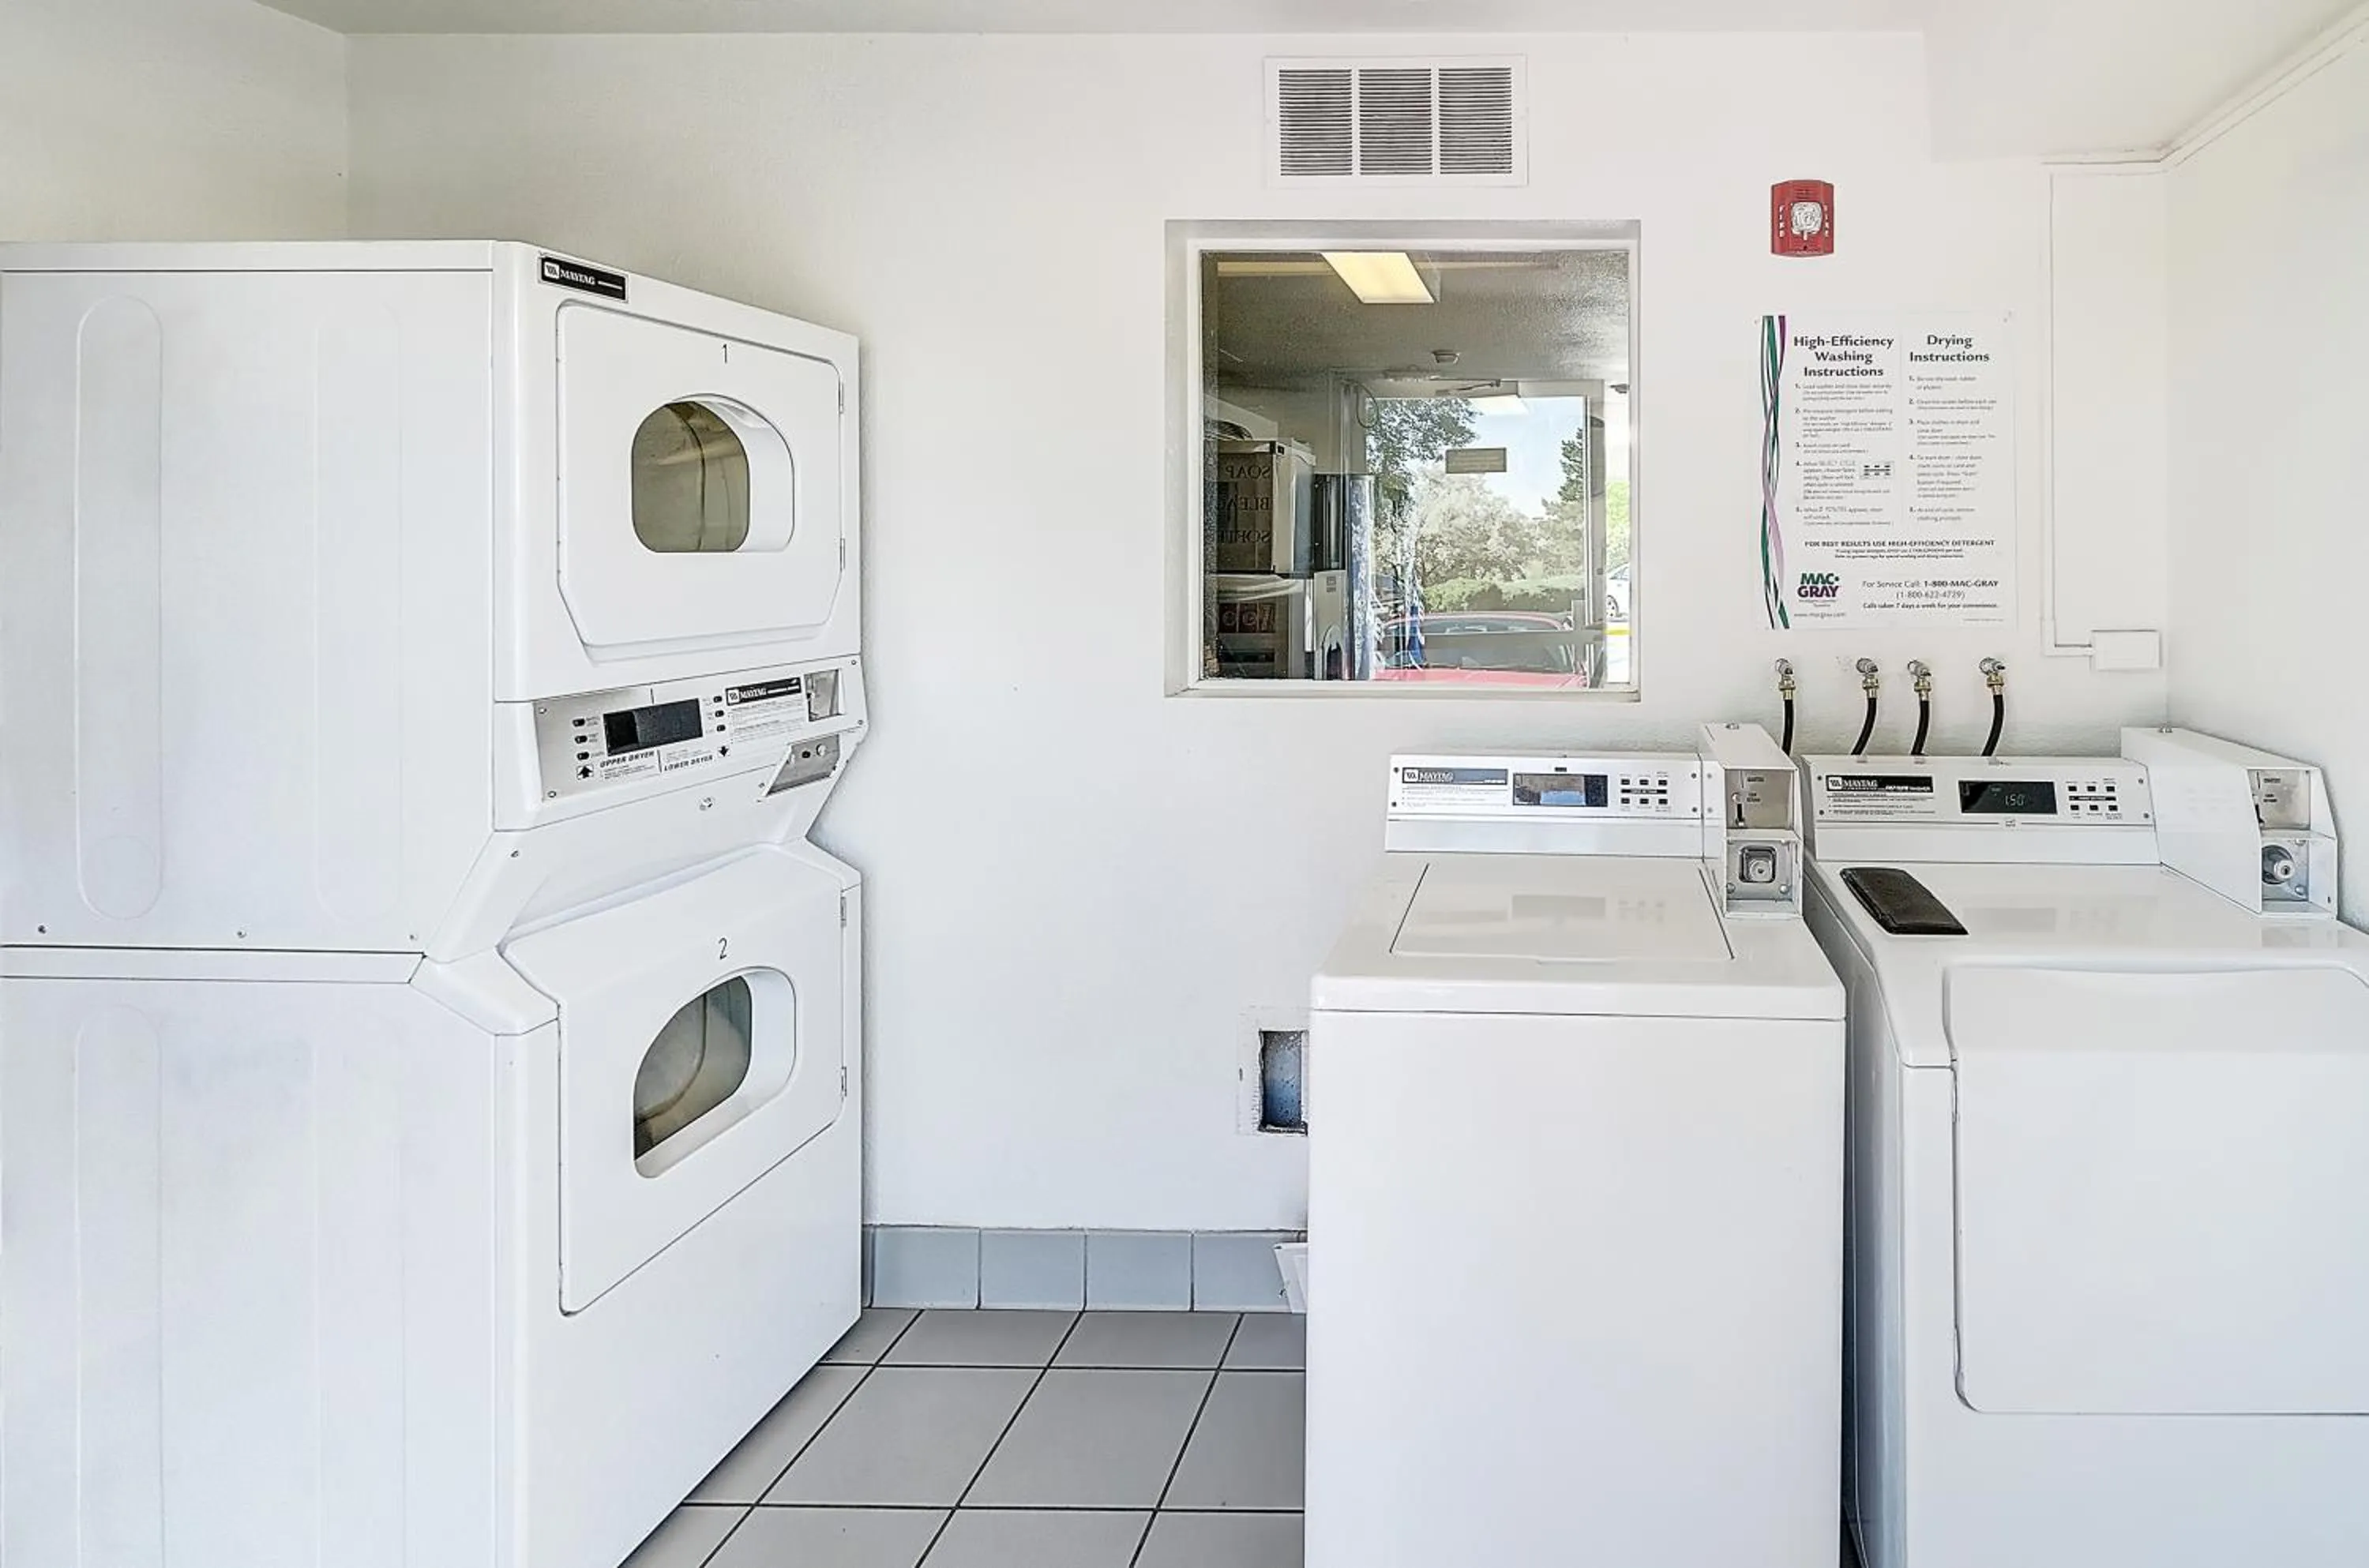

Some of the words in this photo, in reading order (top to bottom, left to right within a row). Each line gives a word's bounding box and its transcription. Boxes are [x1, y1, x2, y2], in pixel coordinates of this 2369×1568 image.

[560, 268, 595, 285] MAYTAG
[1793, 335, 1894, 350] High-Efficiency
[1927, 334, 1973, 349] Drying
[722, 343, 728, 364] 1
[1815, 351, 1873, 365] Washing
[1909, 351, 1990, 362] Instructions
[1804, 366, 1883, 377] Instructions
[1796, 585, 1839, 598] GRAY
[739, 688, 767, 700] MAYTAG
[1419, 771, 1454, 782] MAYTAG
[1842, 779, 1879, 788] MAYTAG
[718, 937, 727, 960] 2
